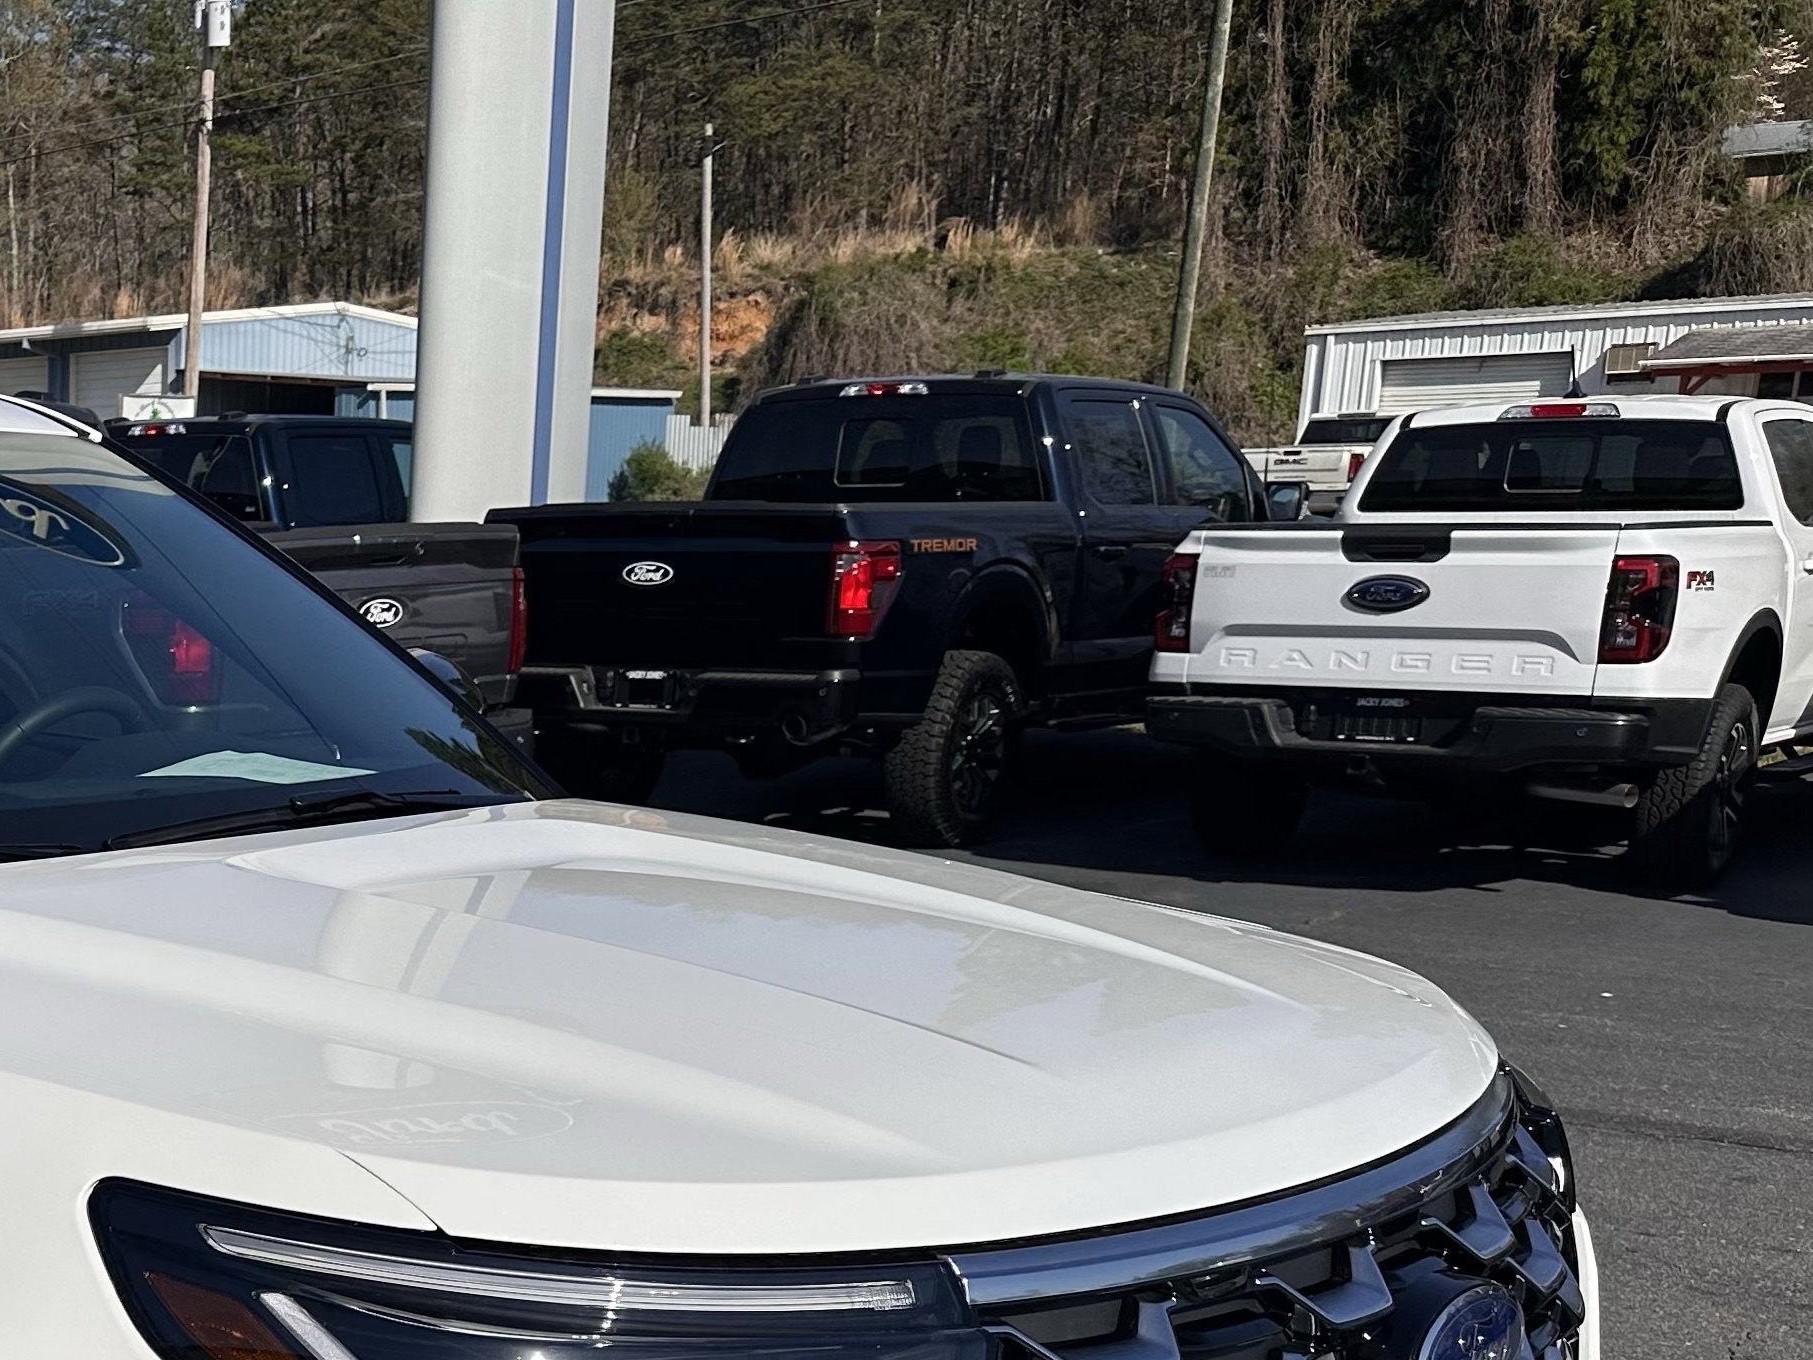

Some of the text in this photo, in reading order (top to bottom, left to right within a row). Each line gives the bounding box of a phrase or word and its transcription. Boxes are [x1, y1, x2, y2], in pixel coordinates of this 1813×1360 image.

[909, 538, 978, 553] TREMOR
[629, 563, 667, 583] Ford
[1686, 570, 1715, 590] FX4
[365, 601, 399, 624] Ford
[1219, 647, 1556, 677] RANGER
